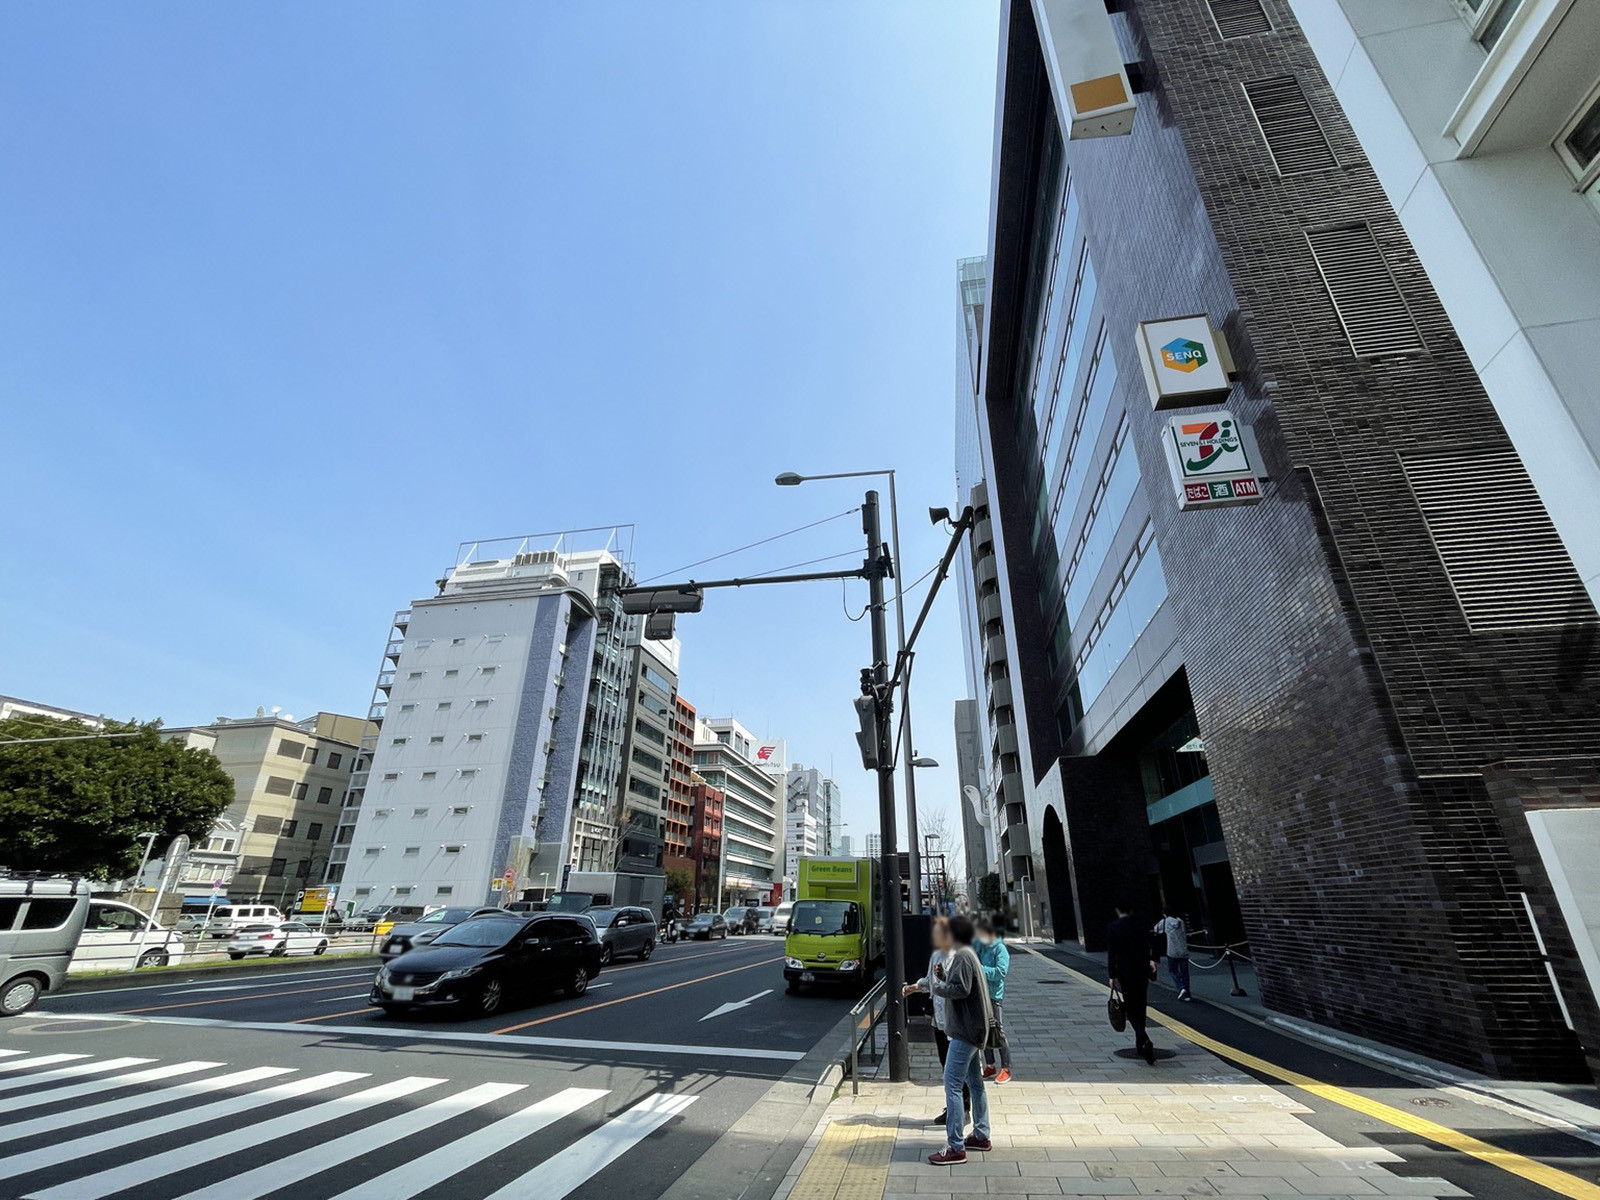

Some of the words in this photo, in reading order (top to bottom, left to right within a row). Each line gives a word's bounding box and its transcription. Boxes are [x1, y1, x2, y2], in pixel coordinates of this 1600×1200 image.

[1166, 350, 1202, 361] SENQ
[1206, 437, 1238, 445] HOLDINGS
[1186, 486, 1209, 498] たばこ
[1213, 483, 1229, 497] 酒
[1235, 481, 1257, 495] ATM
[832, 865, 852, 873] Beans
[296, 891, 304, 901] P
